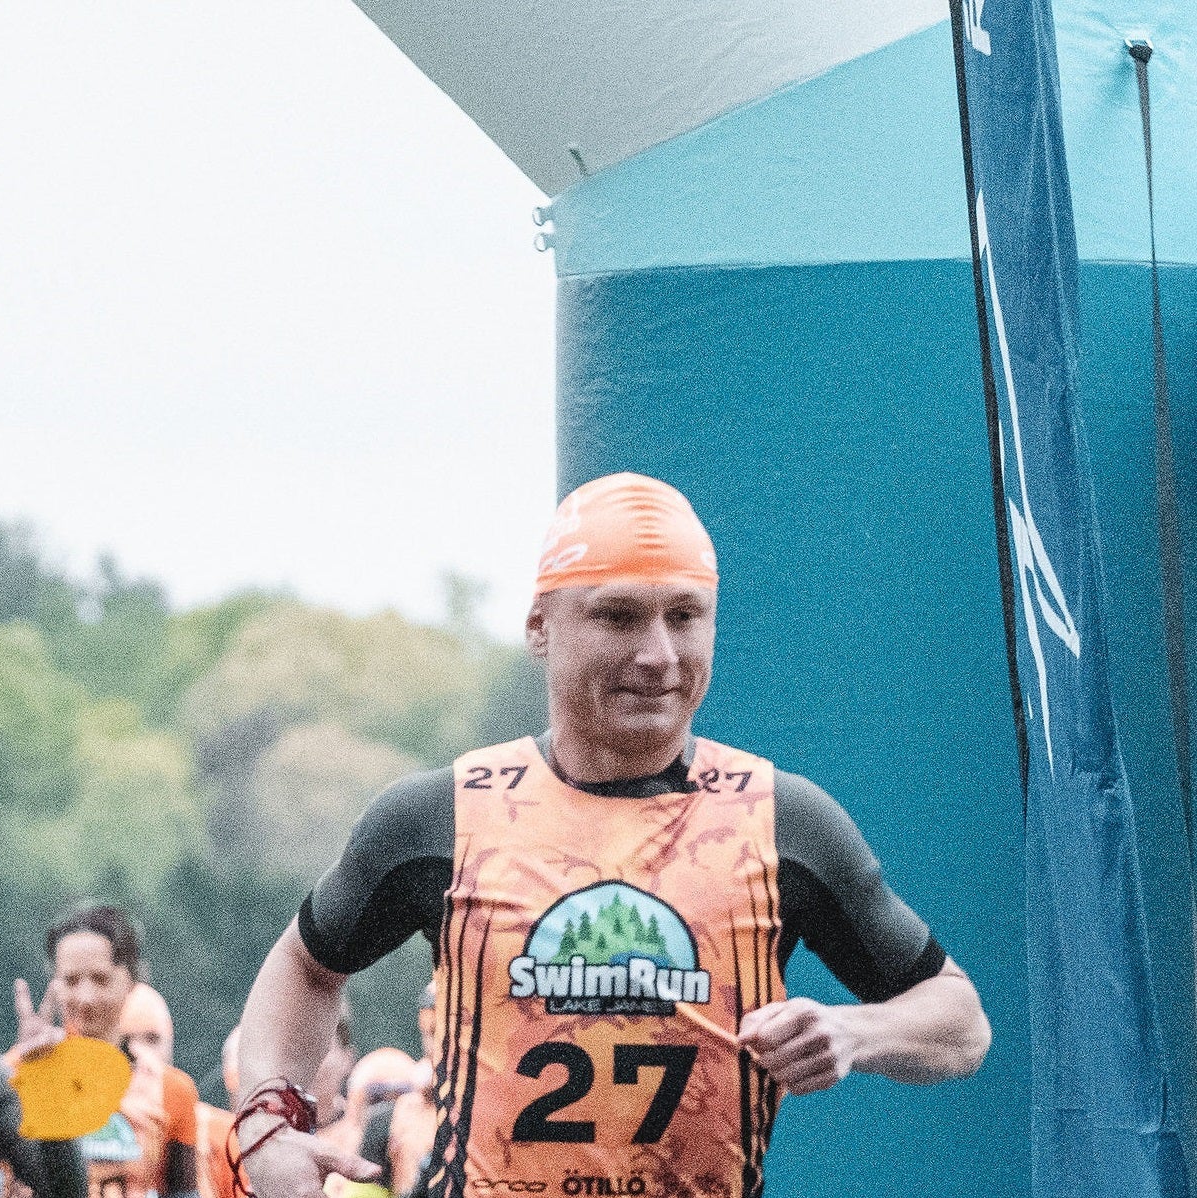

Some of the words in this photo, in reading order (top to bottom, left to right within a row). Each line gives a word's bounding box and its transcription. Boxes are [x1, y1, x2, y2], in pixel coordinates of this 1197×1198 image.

[463, 765, 528, 790] 27
[698, 767, 753, 793] 27
[508, 955, 711, 1004] SwimRun
[510, 1041, 699, 1145] 27
